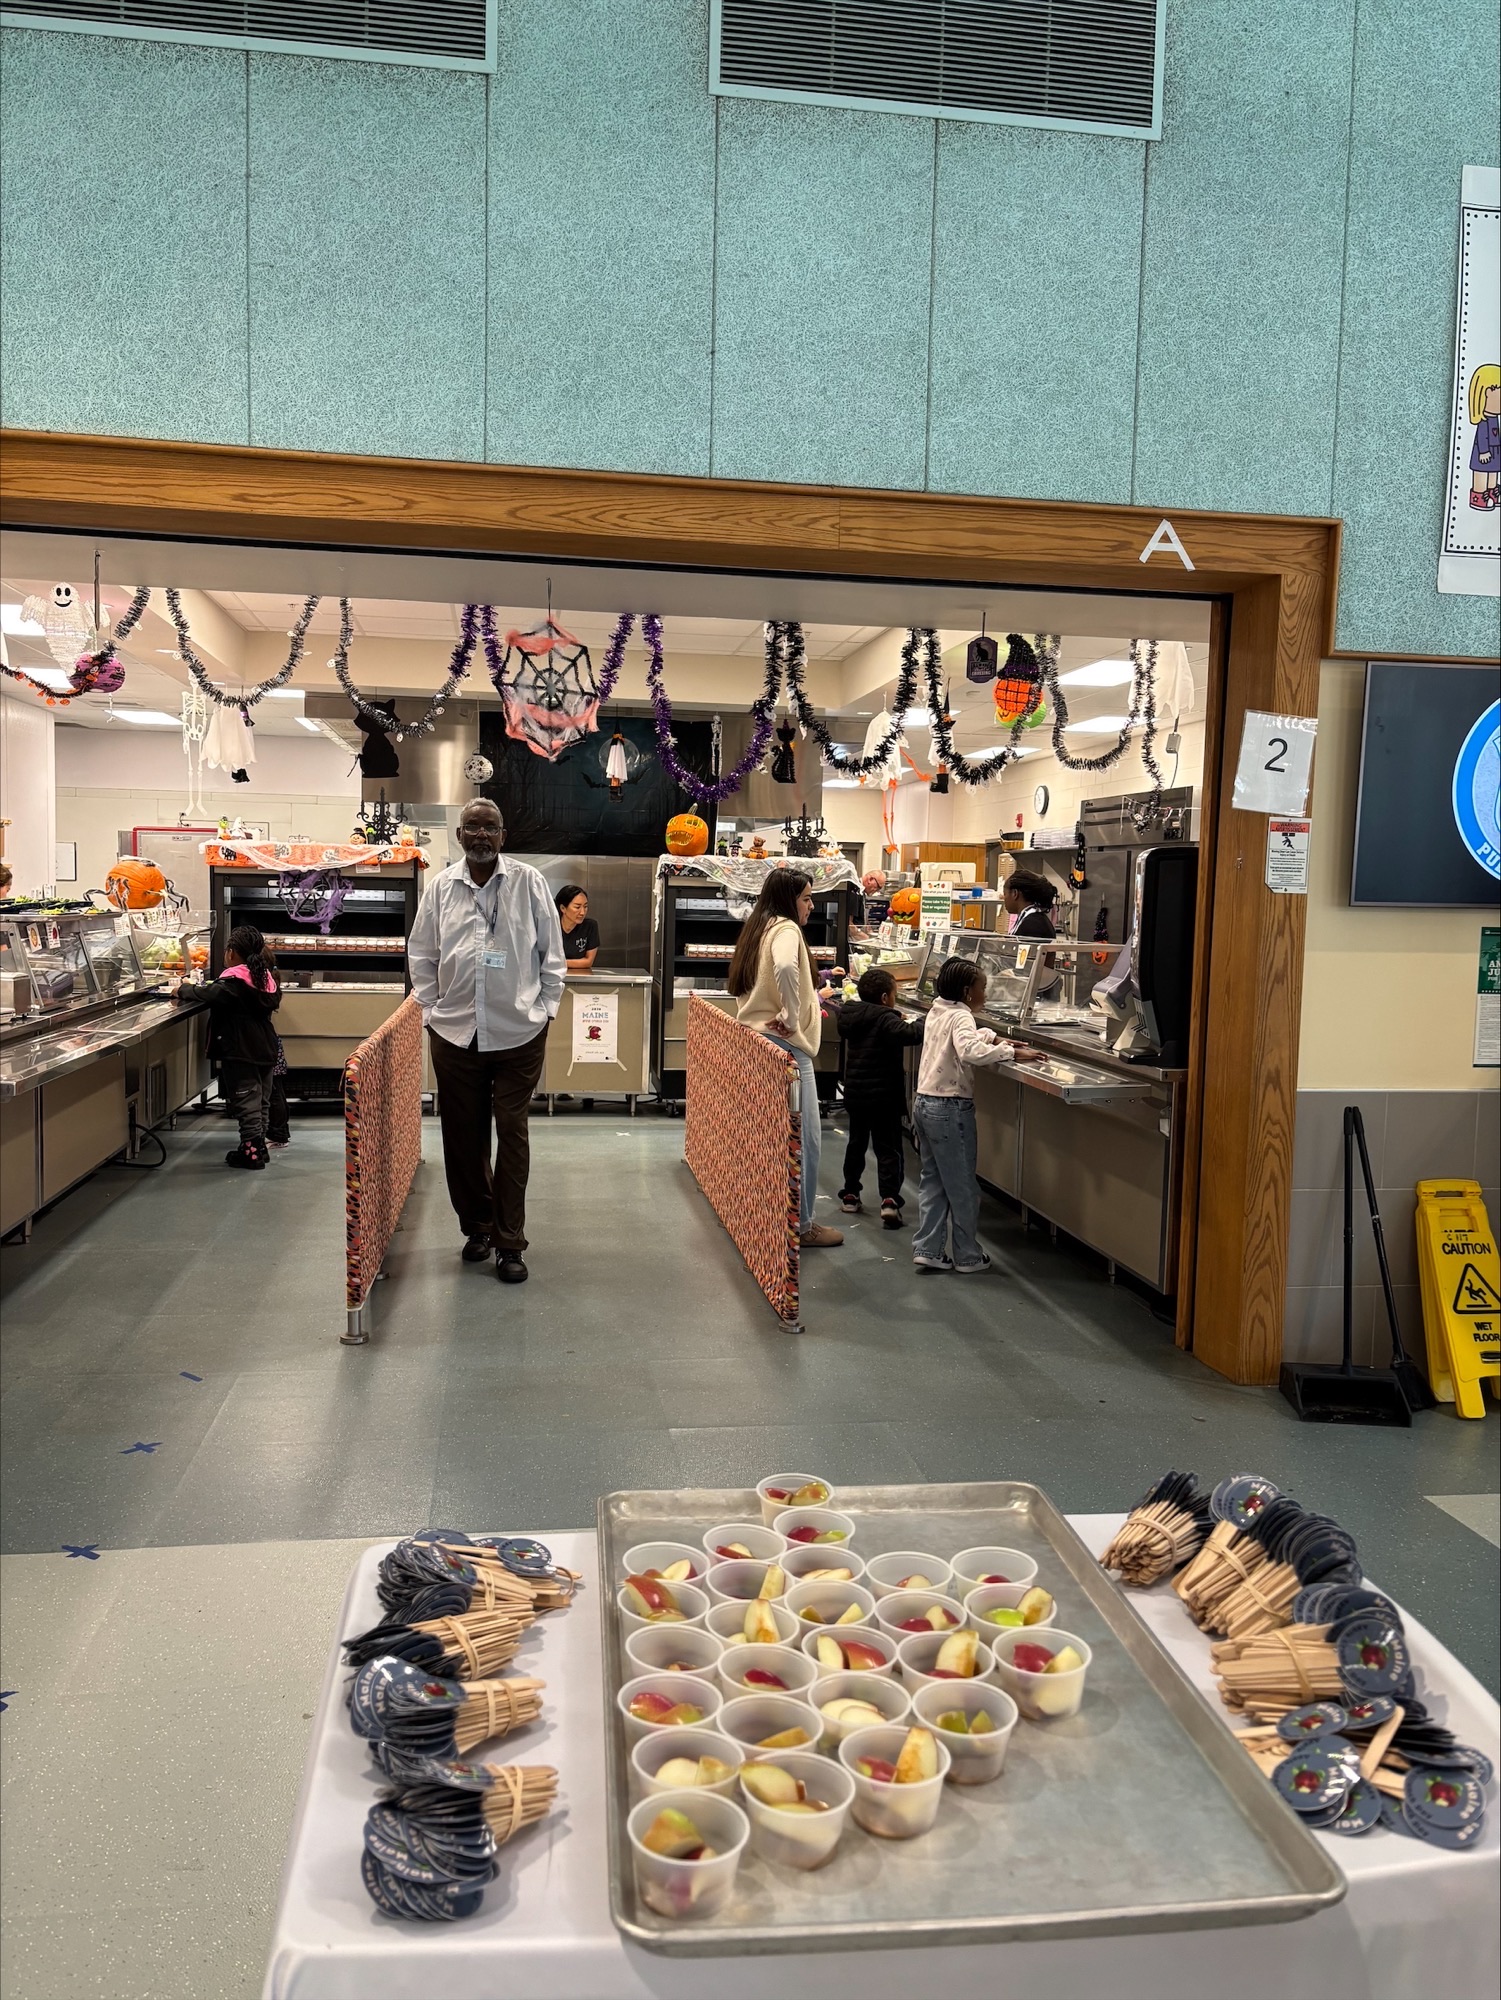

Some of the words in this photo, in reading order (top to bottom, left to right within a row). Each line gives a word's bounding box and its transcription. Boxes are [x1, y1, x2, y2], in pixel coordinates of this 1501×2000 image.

[1138, 518, 1196, 572] A
[1263, 737, 1289, 773] 2
[1442, 1243, 1491, 1254] CAUTION
[1473, 1333, 1500, 1342] FLOOR
[1474, 1322, 1492, 1330] WET
[1389, 1639, 1406, 1681] Maine
[375, 1676, 389, 1713] Main
[1335, 1817, 1364, 1829] Mai
